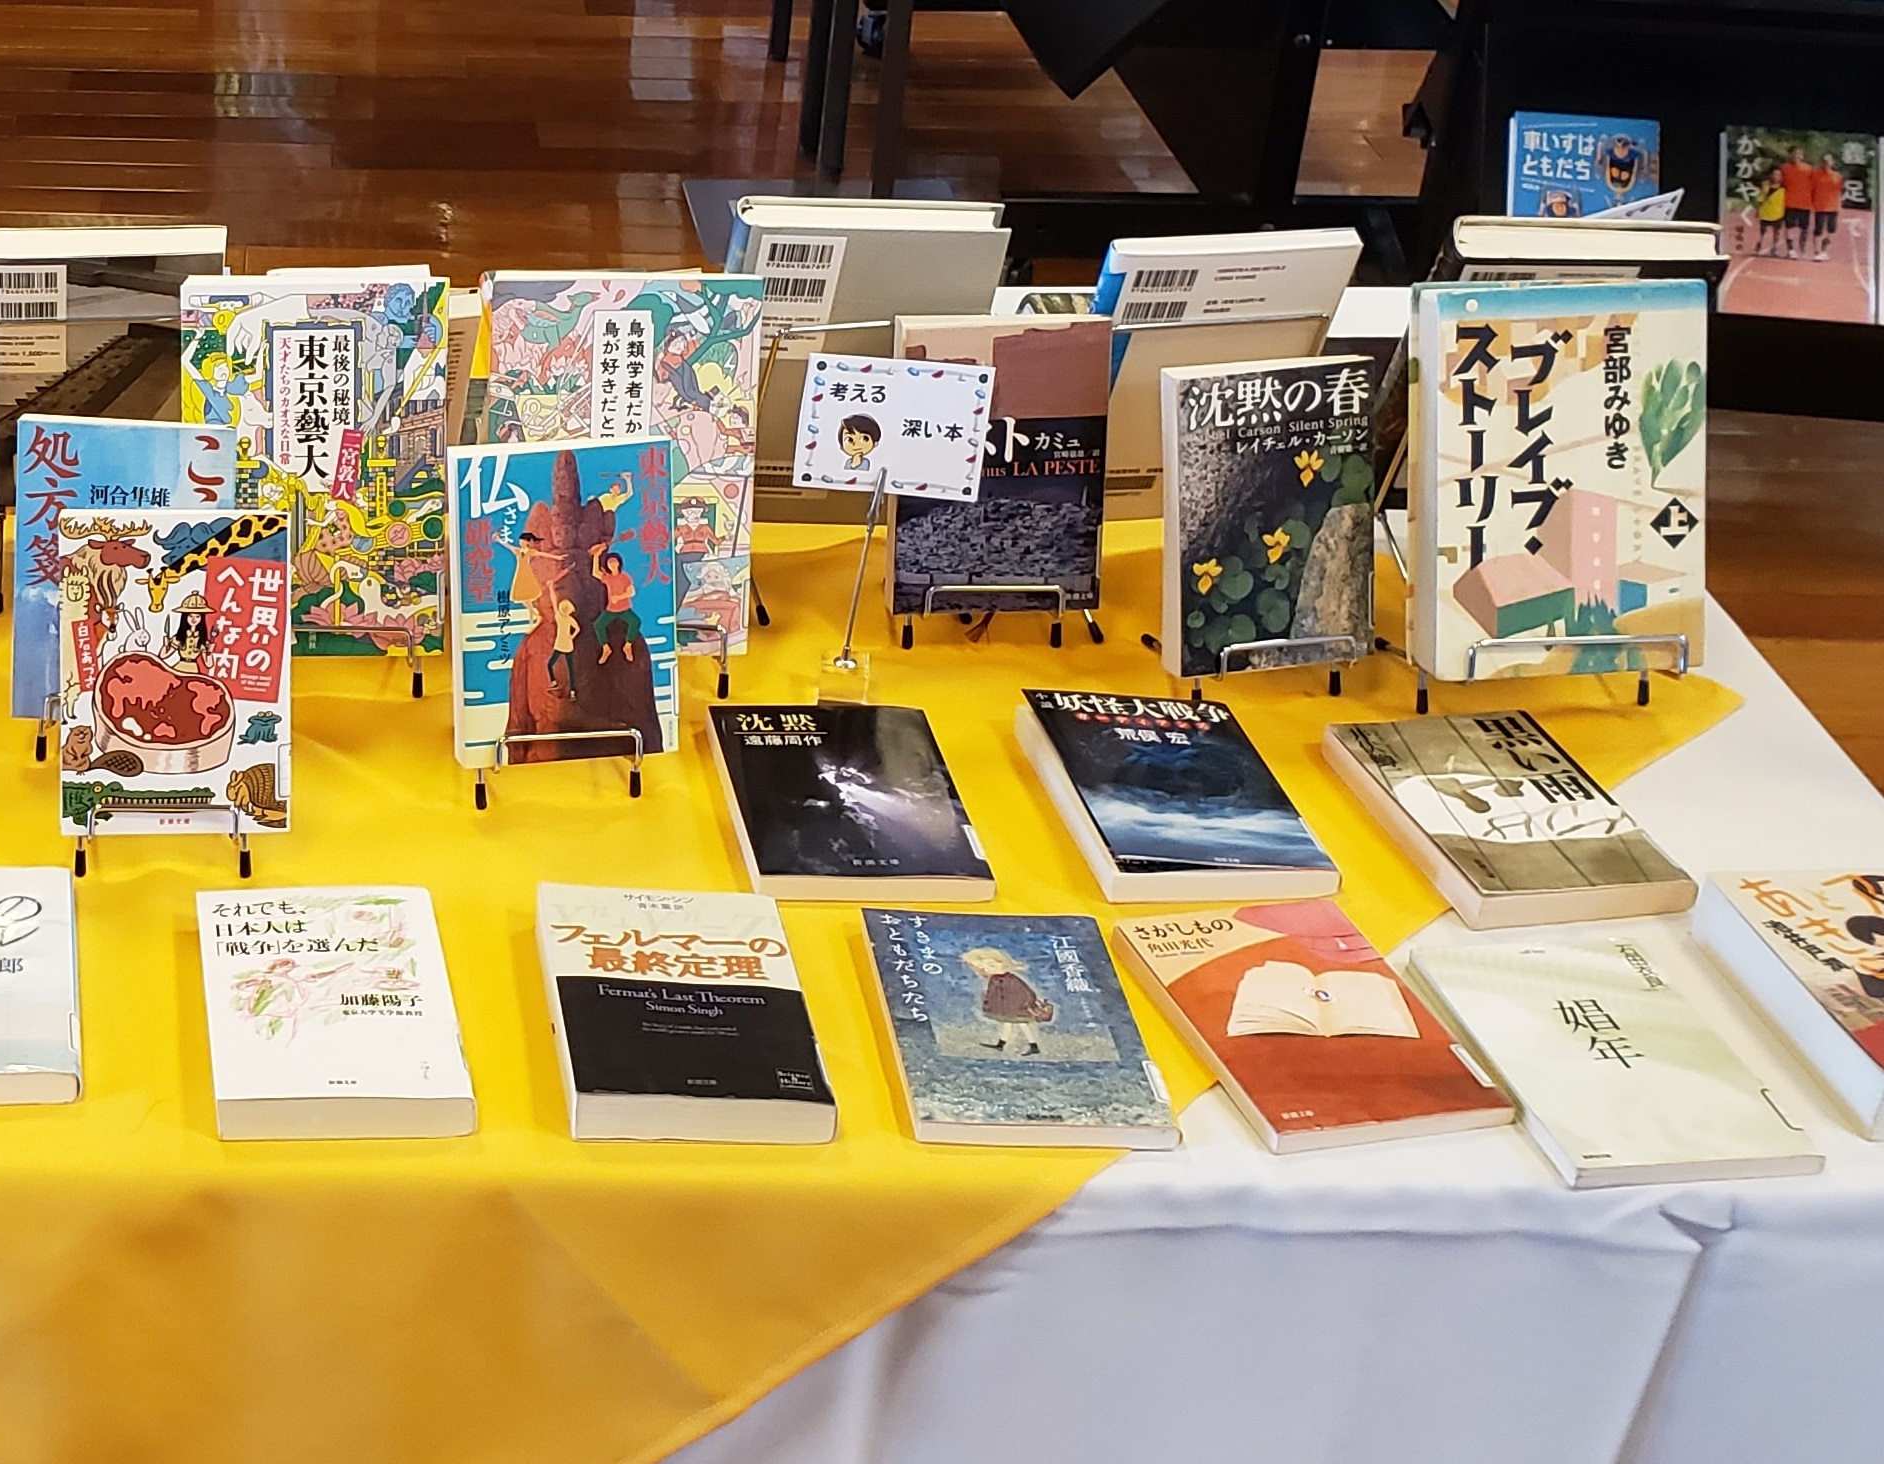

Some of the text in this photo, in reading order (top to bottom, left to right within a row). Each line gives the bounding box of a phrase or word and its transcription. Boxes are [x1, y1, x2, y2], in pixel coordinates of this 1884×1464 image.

[1523, 130, 1594, 157] 車いすは
[1522, 154, 1591, 181] ともだち
[332, 334, 352, 426] 最後の秘境
[600, 318, 621, 438] 鳥が好きだと
[624, 318, 646, 434] 鳥類学者だか
[829, 382, 887, 403] 考える
[278, 336, 293, 466] 天才たちのカオスな日常
[294, 334, 330, 480] 東京藝大
[1188, 368, 1370, 431] 沈黙の春
[1603, 325, 1632, 470] 宮部みゆき
[901, 419, 964, 442] 深い本
[1033, 432, 1082, 451] カミュ
[1235, 428, 1368, 454] レイチェル・カーソン
[1237, 425, 1281, 439] Carson
[1288, 417, 1325, 433] Silent
[1327, 415, 1369, 430] Spring
[1453, 323, 1501, 570] ストーリー
[335, 431, 362, 499] 二宮敦人
[1012, 461, 1039, 477] LA
[1043, 459, 1101, 476] PESTE
[89, 484, 172, 508] 河合隼雄
[459, 454, 531, 544] 仏さま
[639, 445, 672, 587] 東京藝大
[1659, 504, 1691, 537] 上
[464, 518, 495, 605] 研究室
[208, 565, 246, 680] へんな肉
[245, 567, 284, 673] 世界の
[496, 589, 515, 665] 樹原アンミツ
[77, 623, 97, 691] 白石あづさ
[735, 713, 818, 731] 沈黙
[1052, 692, 1231, 723] 妖怪大戦争
[744, 735, 824, 746] 遠藤周作
[1473, 716, 1596, 804] 黒い雨
[215, 919, 308, 938] 日本人は
[550, 924, 789, 957] フェルマーの
[908, 915, 944, 976] すきまの
[1133, 918, 1234, 940] さがしもの
[1146, 937, 1215, 955] 角田光代
[215, 938, 380, 957] 「戦争」を選んだ
[585, 945, 771, 981] 最終定理
[1049, 935, 1091, 993] 江國香織
[880, 913, 930, 1023] おともだちたち
[339, 993, 423, 1008] 加藤陽子
[597, 983, 767, 1006] Fermat's Last Theorem
[645, 1000, 725, 1018] Simon Singh
[1552, 998, 1646, 1069] 娼年
